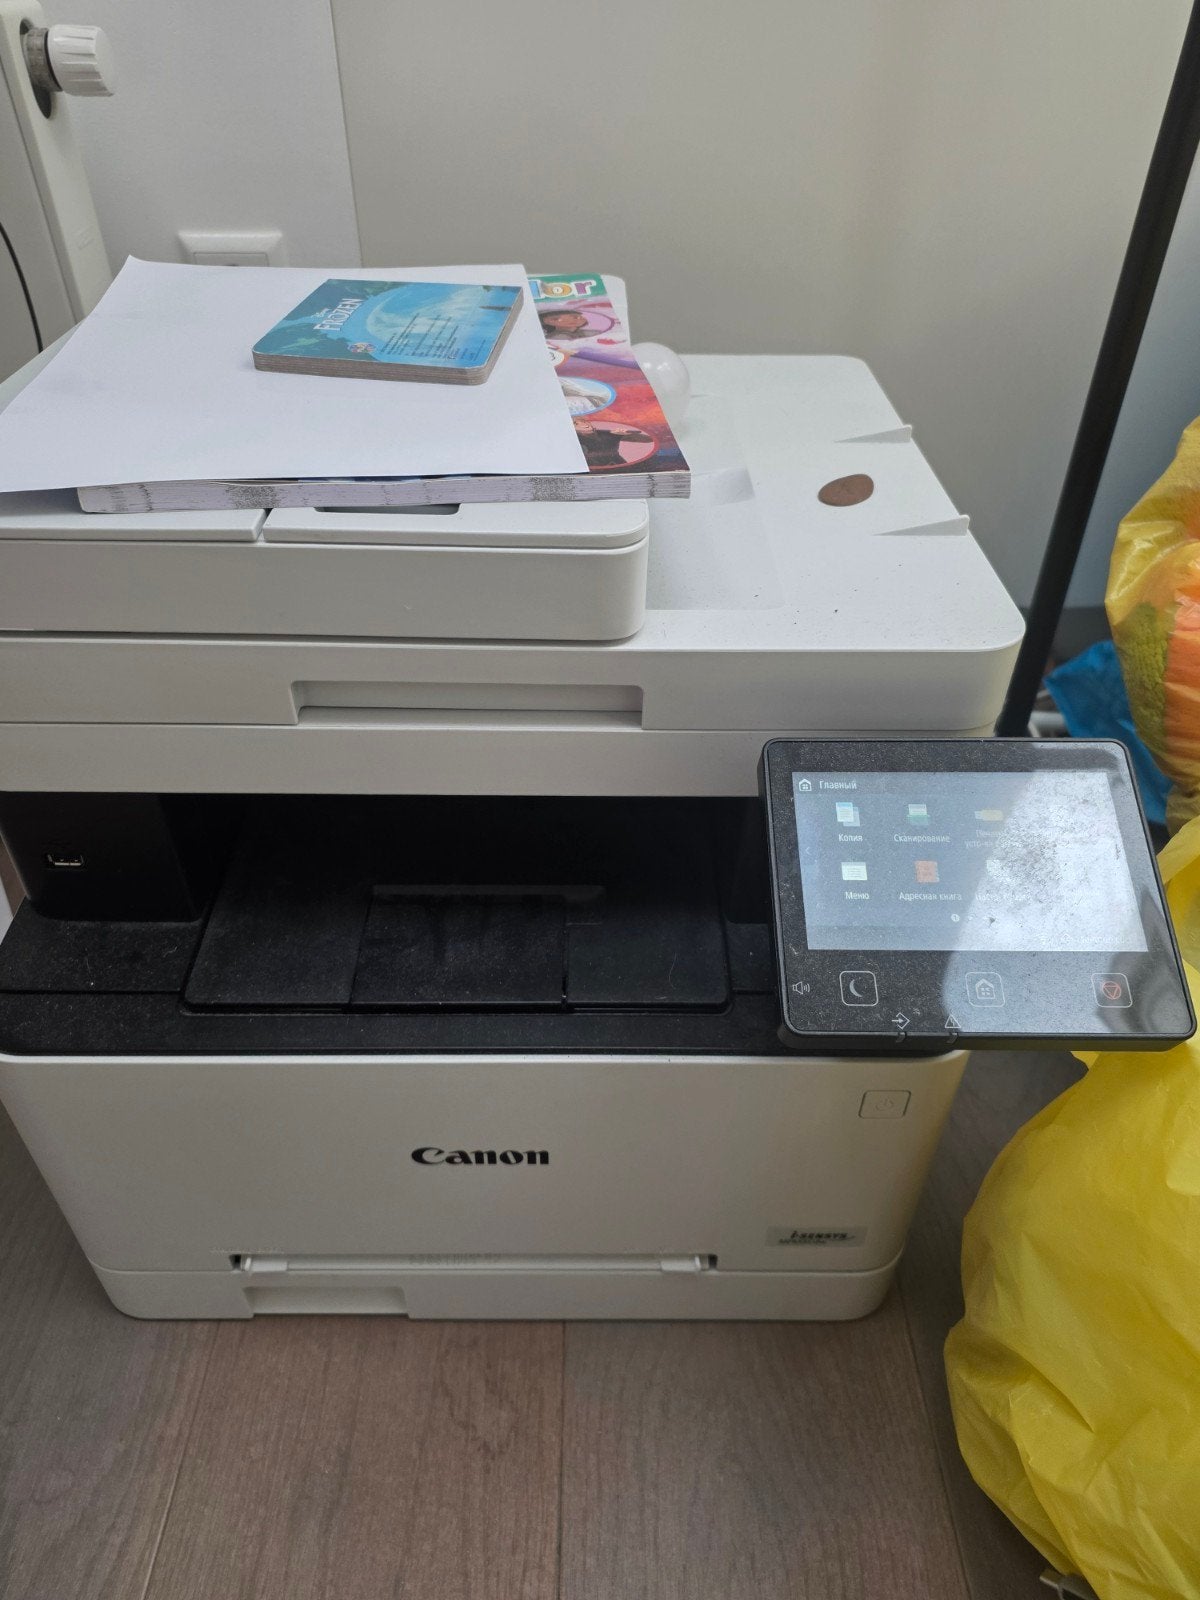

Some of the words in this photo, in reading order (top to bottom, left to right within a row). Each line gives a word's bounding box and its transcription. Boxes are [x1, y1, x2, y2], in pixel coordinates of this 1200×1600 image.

[313, 298, 364, 330] FROZEN
[819, 780, 857, 790] Главный
[838, 833, 863, 842] Копия
[893, 833, 950, 843] Сканирование
[845, 891, 869, 900] Меню
[899, 891, 937, 902] Адресная
[940, 893, 962, 901] книга
[411, 1147, 549, 1165] Canon
